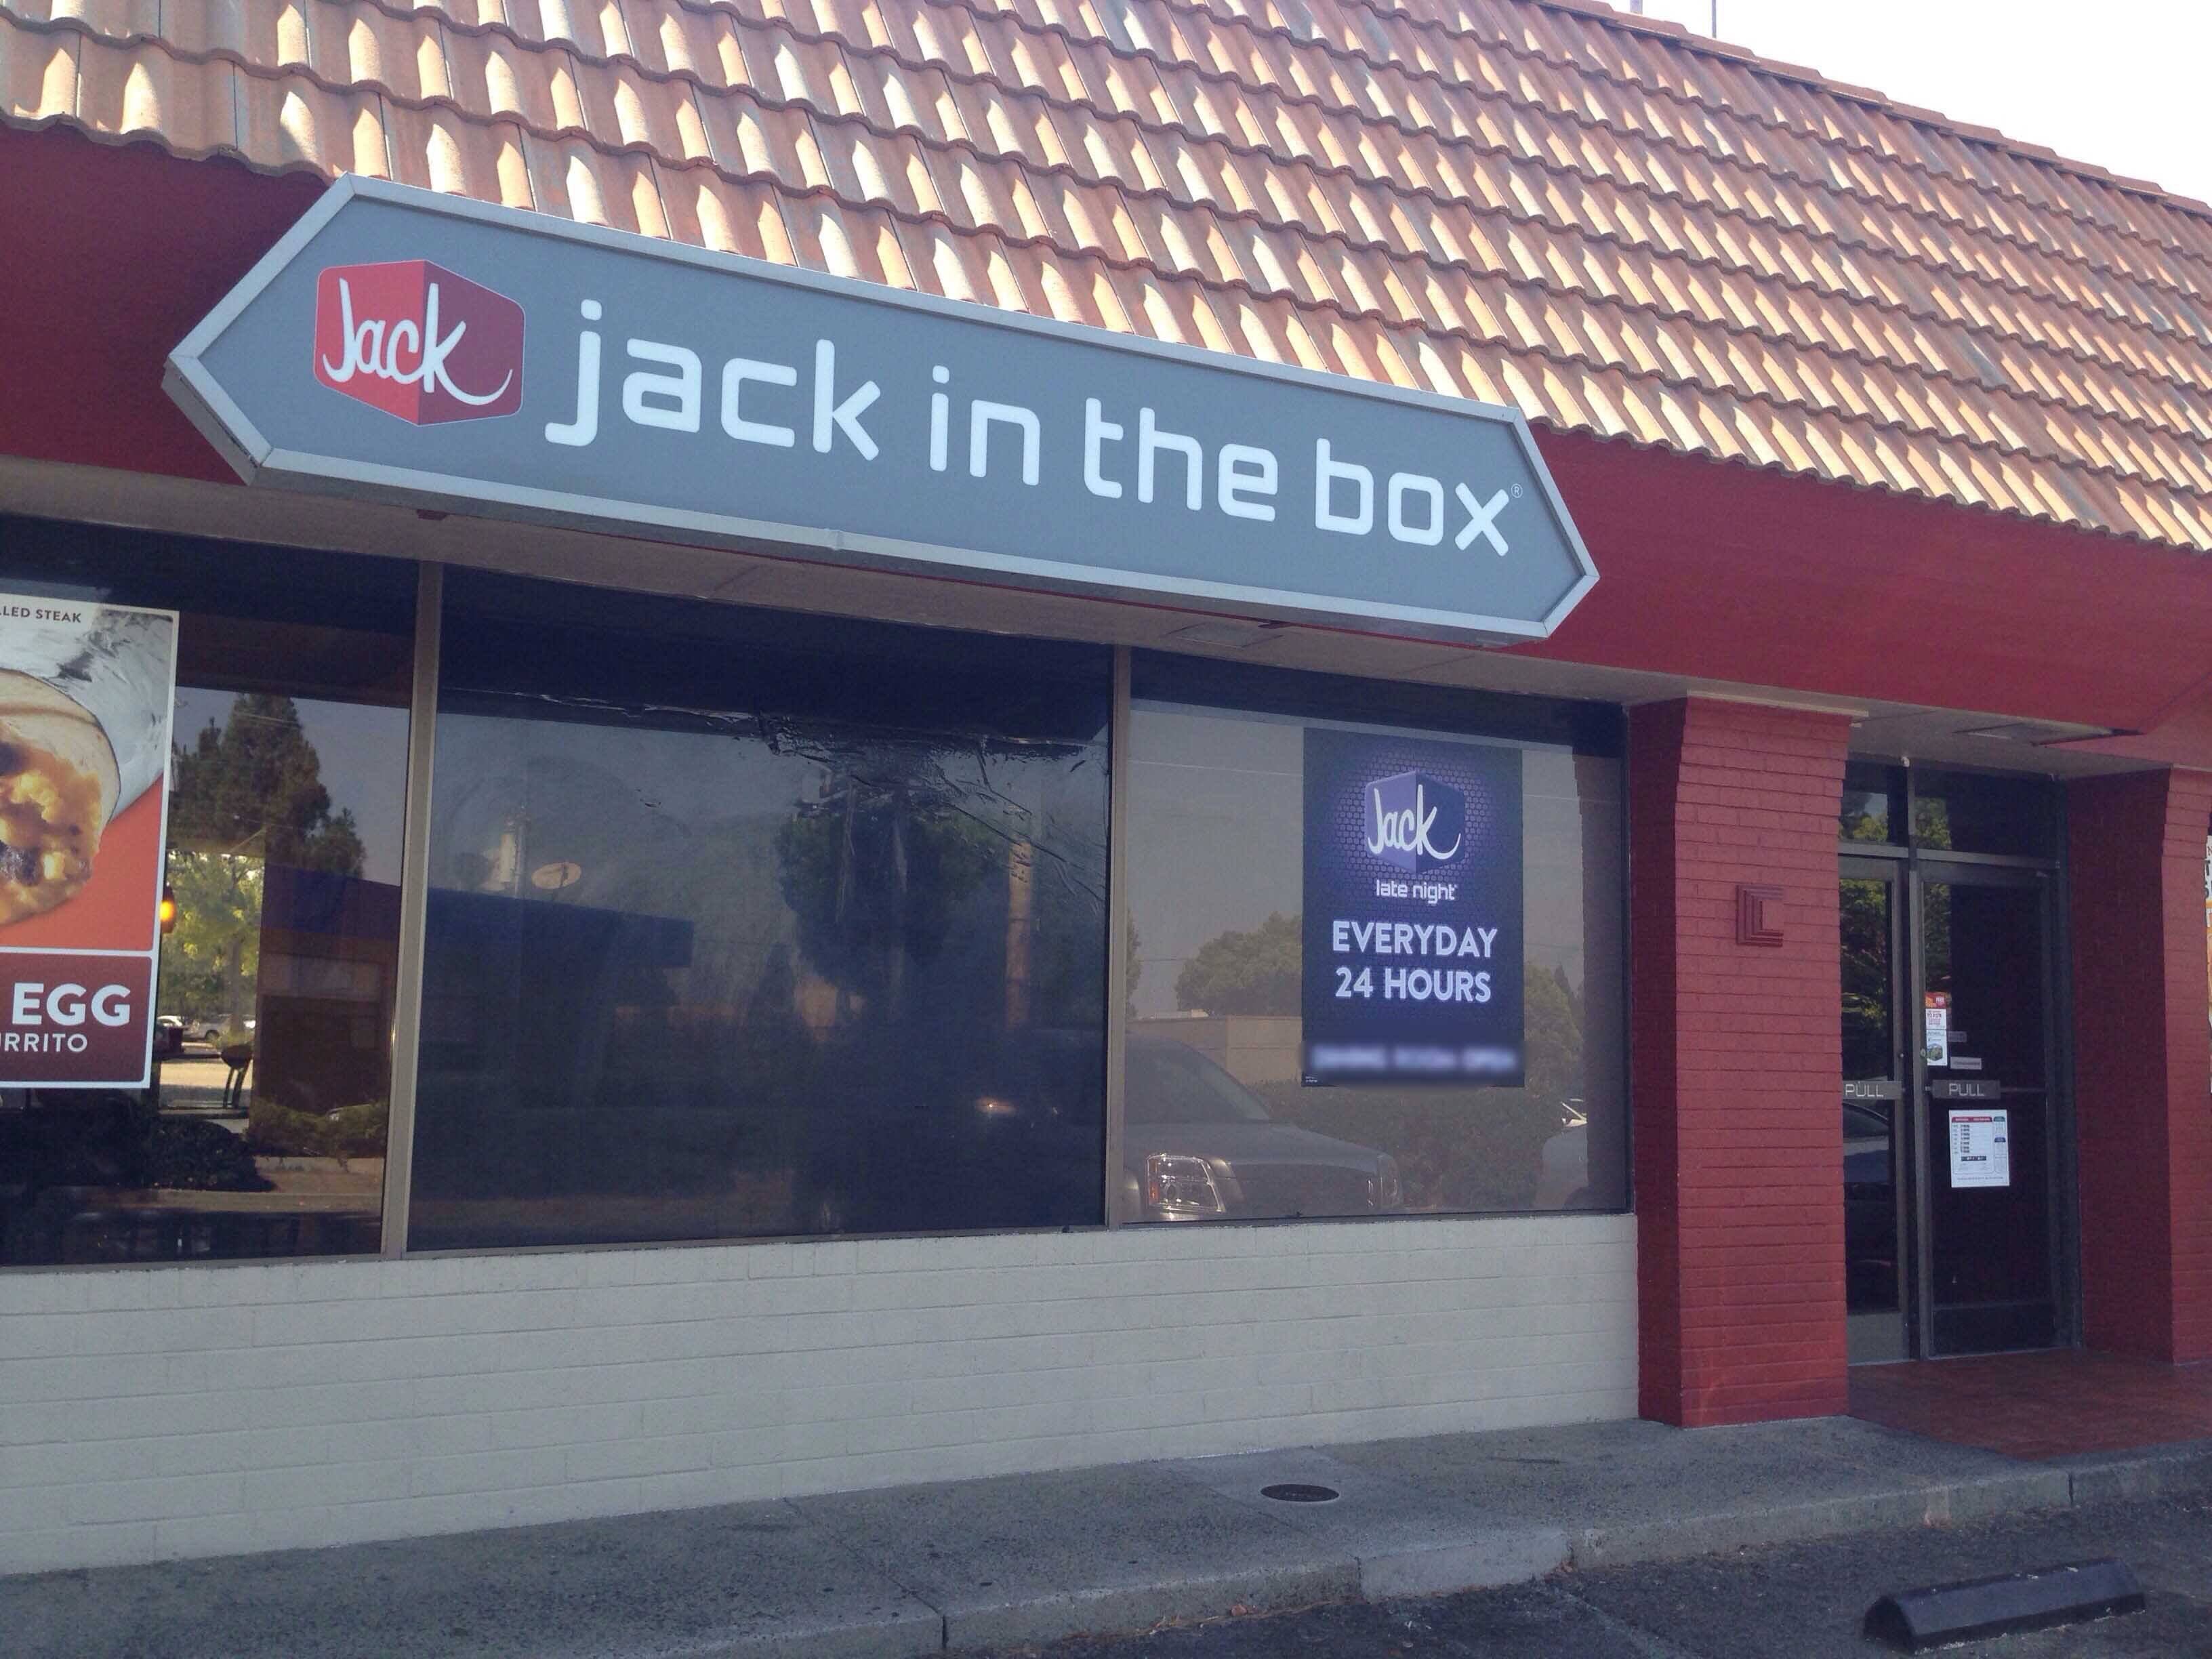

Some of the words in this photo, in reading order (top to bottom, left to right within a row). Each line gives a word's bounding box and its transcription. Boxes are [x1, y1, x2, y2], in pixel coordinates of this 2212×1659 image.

[323, 278, 515, 405] Jack
[544, 299, 882, 461] jack
[929, 365, 1040, 486] in
[1084, 397, 1278, 522] the
[0, 606, 30, 618] LED
[35, 609, 81, 623] STEAK
[1368, 784, 1462, 860] Jack
[1376, 879, 1408, 898] late
[1412, 882, 1455, 904] night
[1332, 920, 1498, 958] EVERYDAY
[1335, 966, 1374, 998] 24
[1385, 967, 1491, 1003] HOURS
[12, 982, 131, 1027] EGG
[0, 1032, 88, 1052] RRITO
[1845, 1084, 1884, 1097] PULL
[1948, 1083, 1985, 1097] PULL
